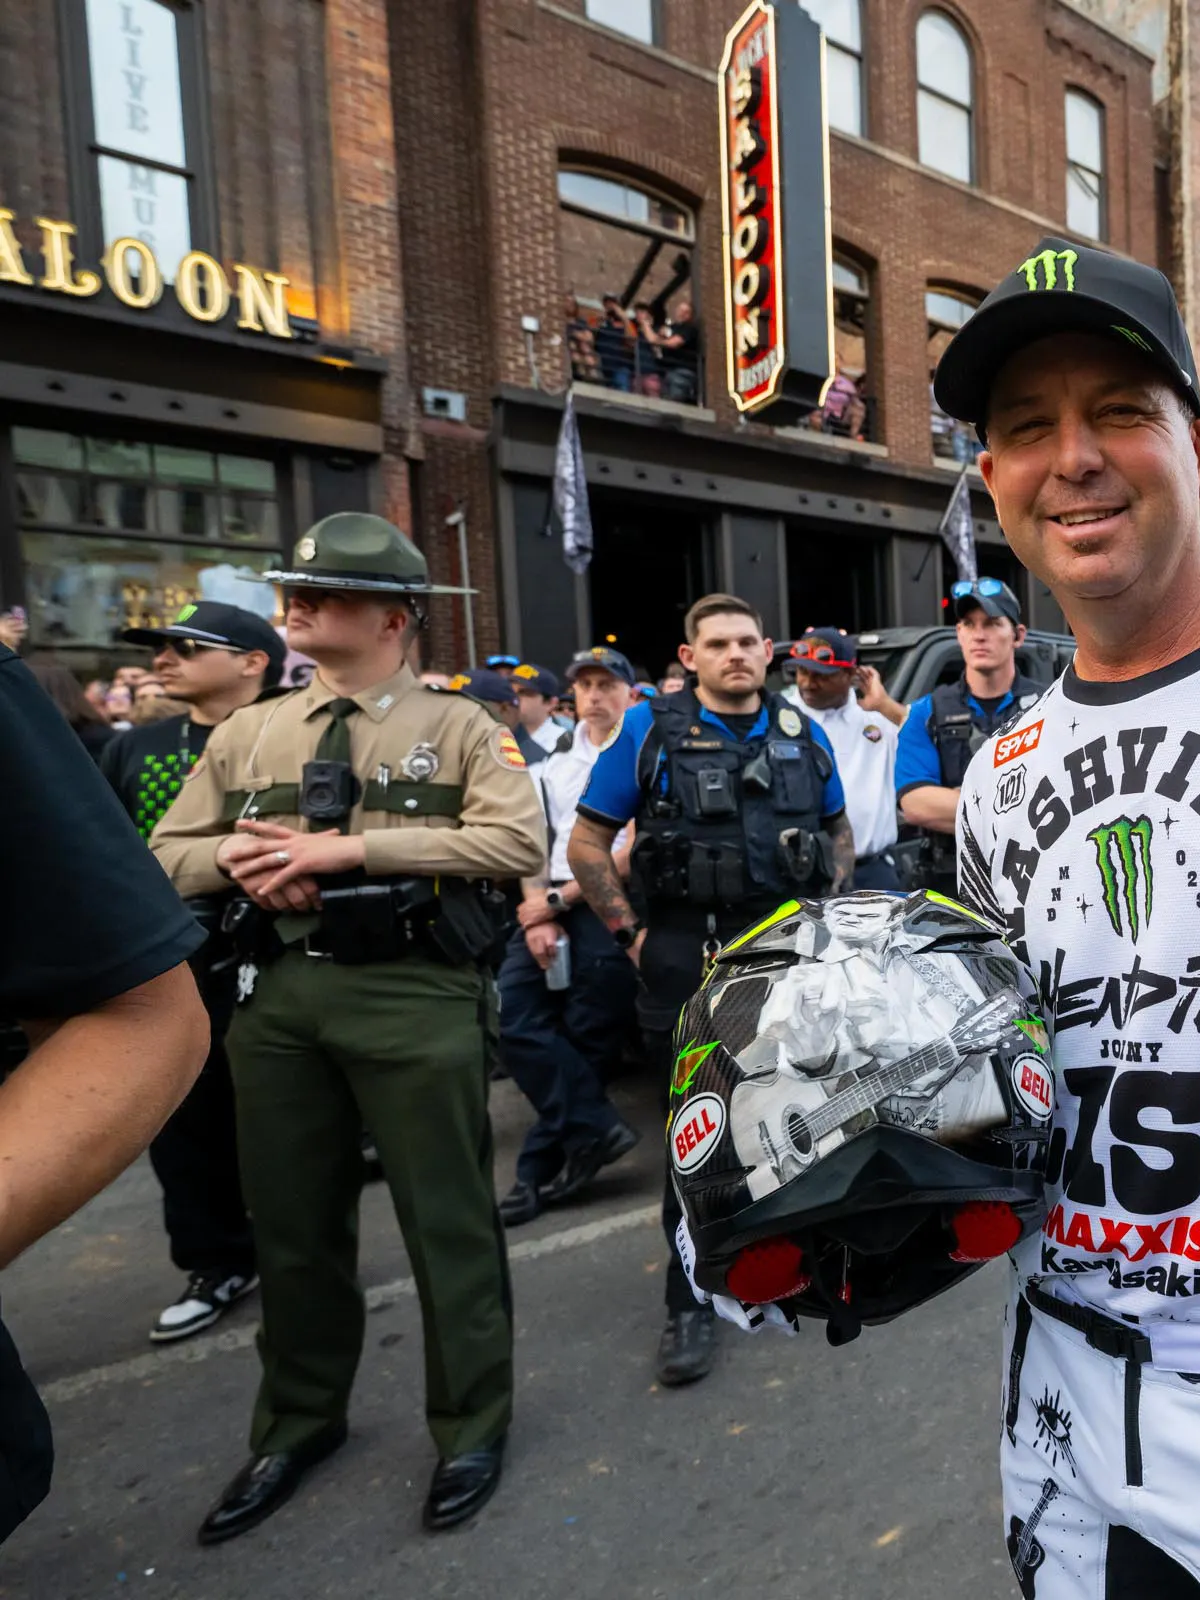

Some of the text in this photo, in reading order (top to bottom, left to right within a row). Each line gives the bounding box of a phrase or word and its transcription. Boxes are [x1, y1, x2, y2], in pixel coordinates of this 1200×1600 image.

[730, 66, 764, 355] SALOON
[1020, 1065, 1052, 1110] BELL
[676, 1108, 717, 1162] BELL
